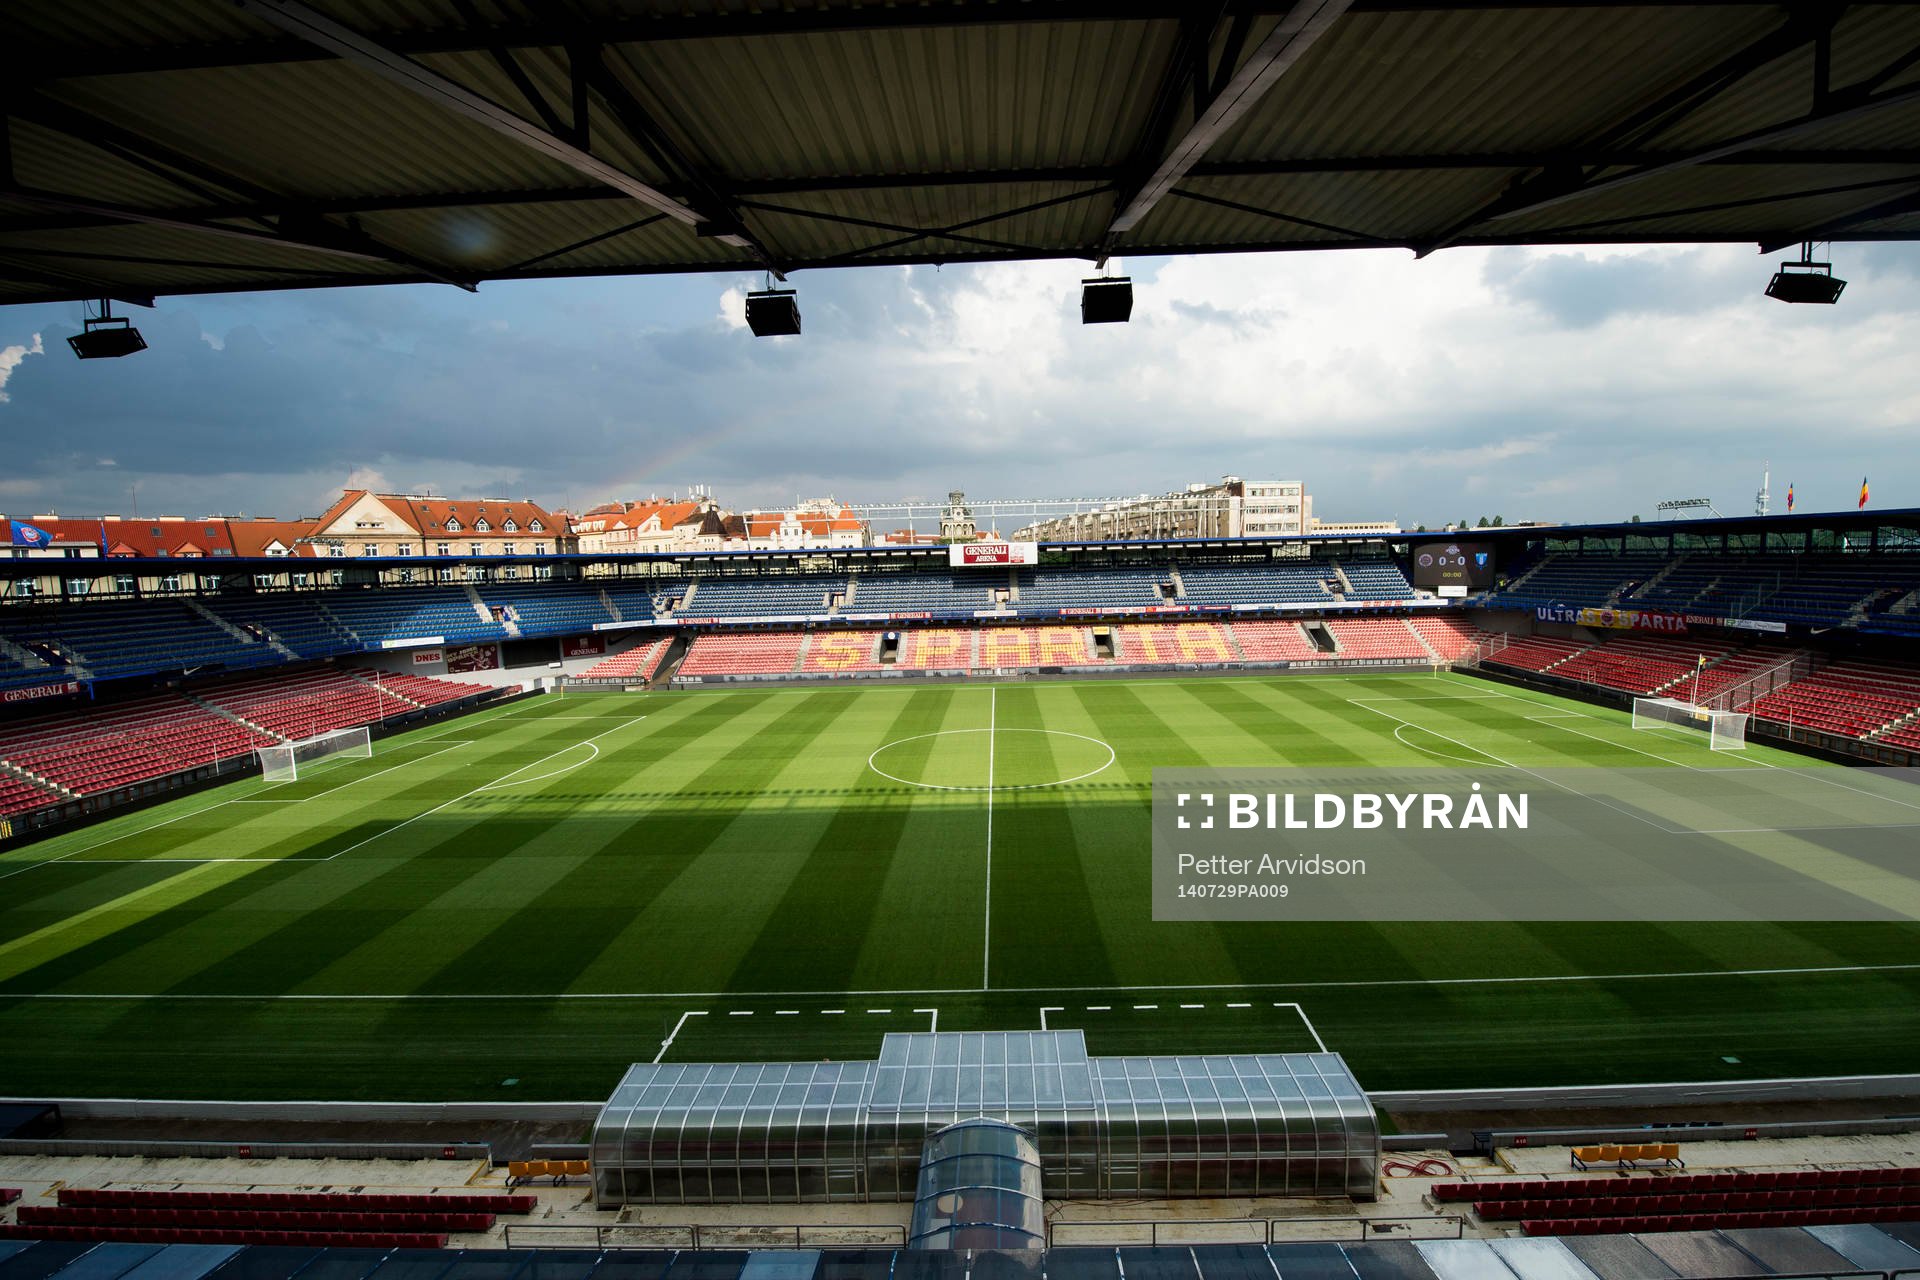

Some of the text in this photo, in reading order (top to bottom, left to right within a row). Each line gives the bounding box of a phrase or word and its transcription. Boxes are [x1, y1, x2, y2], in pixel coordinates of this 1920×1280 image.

[965, 546, 1007, 555] GENERALI
[1439, 556, 1447, 566] 0
[1457, 556, 1465, 566] 0
[1537, 607, 1596, 624] ULTRAS
[1686, 615, 1714, 625] ENERALI
[1618, 612, 1688, 631] SPARTA
[816, 624, 1230, 668] SPARTA
[571, 648, 598, 656] GENERALI
[415, 653, 441, 662] DNES
[4, 684, 63, 701] GENERALI
